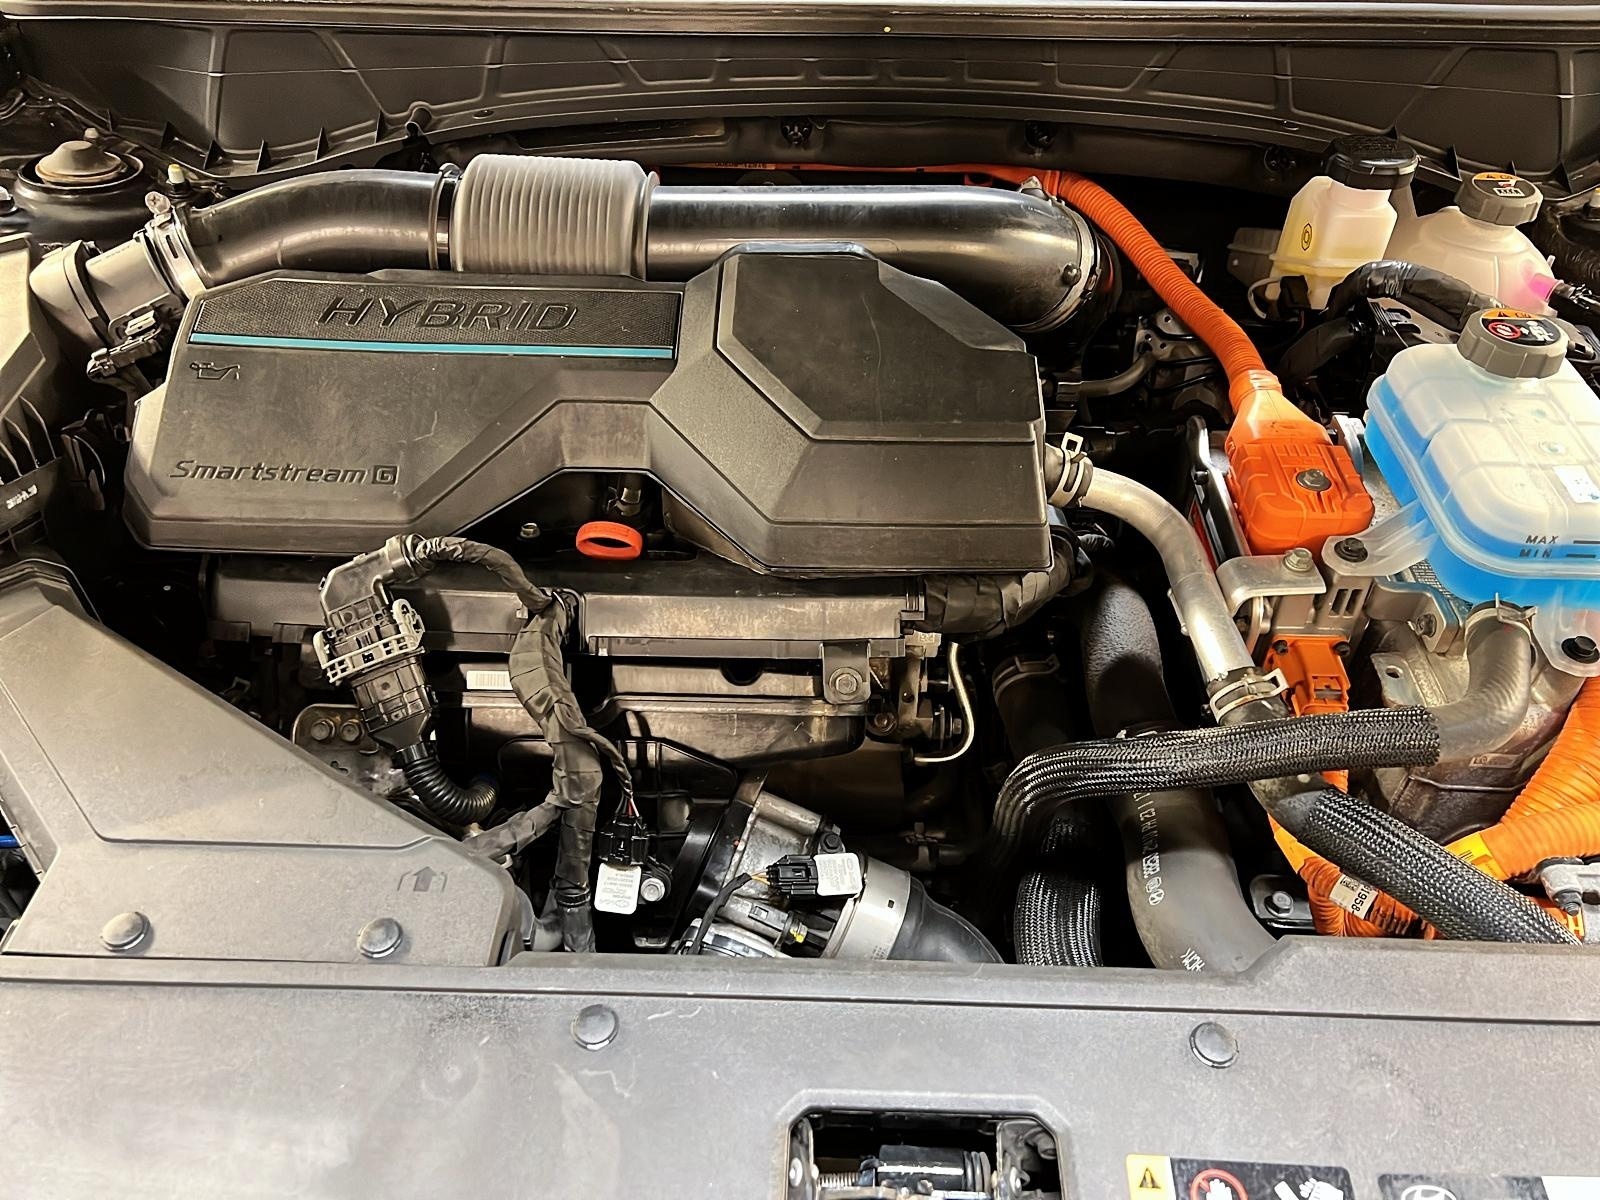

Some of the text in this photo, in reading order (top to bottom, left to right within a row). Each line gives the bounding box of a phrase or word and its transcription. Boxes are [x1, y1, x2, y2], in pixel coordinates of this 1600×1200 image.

[315, 297, 578, 331] HYBRID
[170, 460, 397, 484] Smartstream G
[1525, 534, 1559, 545] MAX
[1519, 548, 1553, 558] MIN
